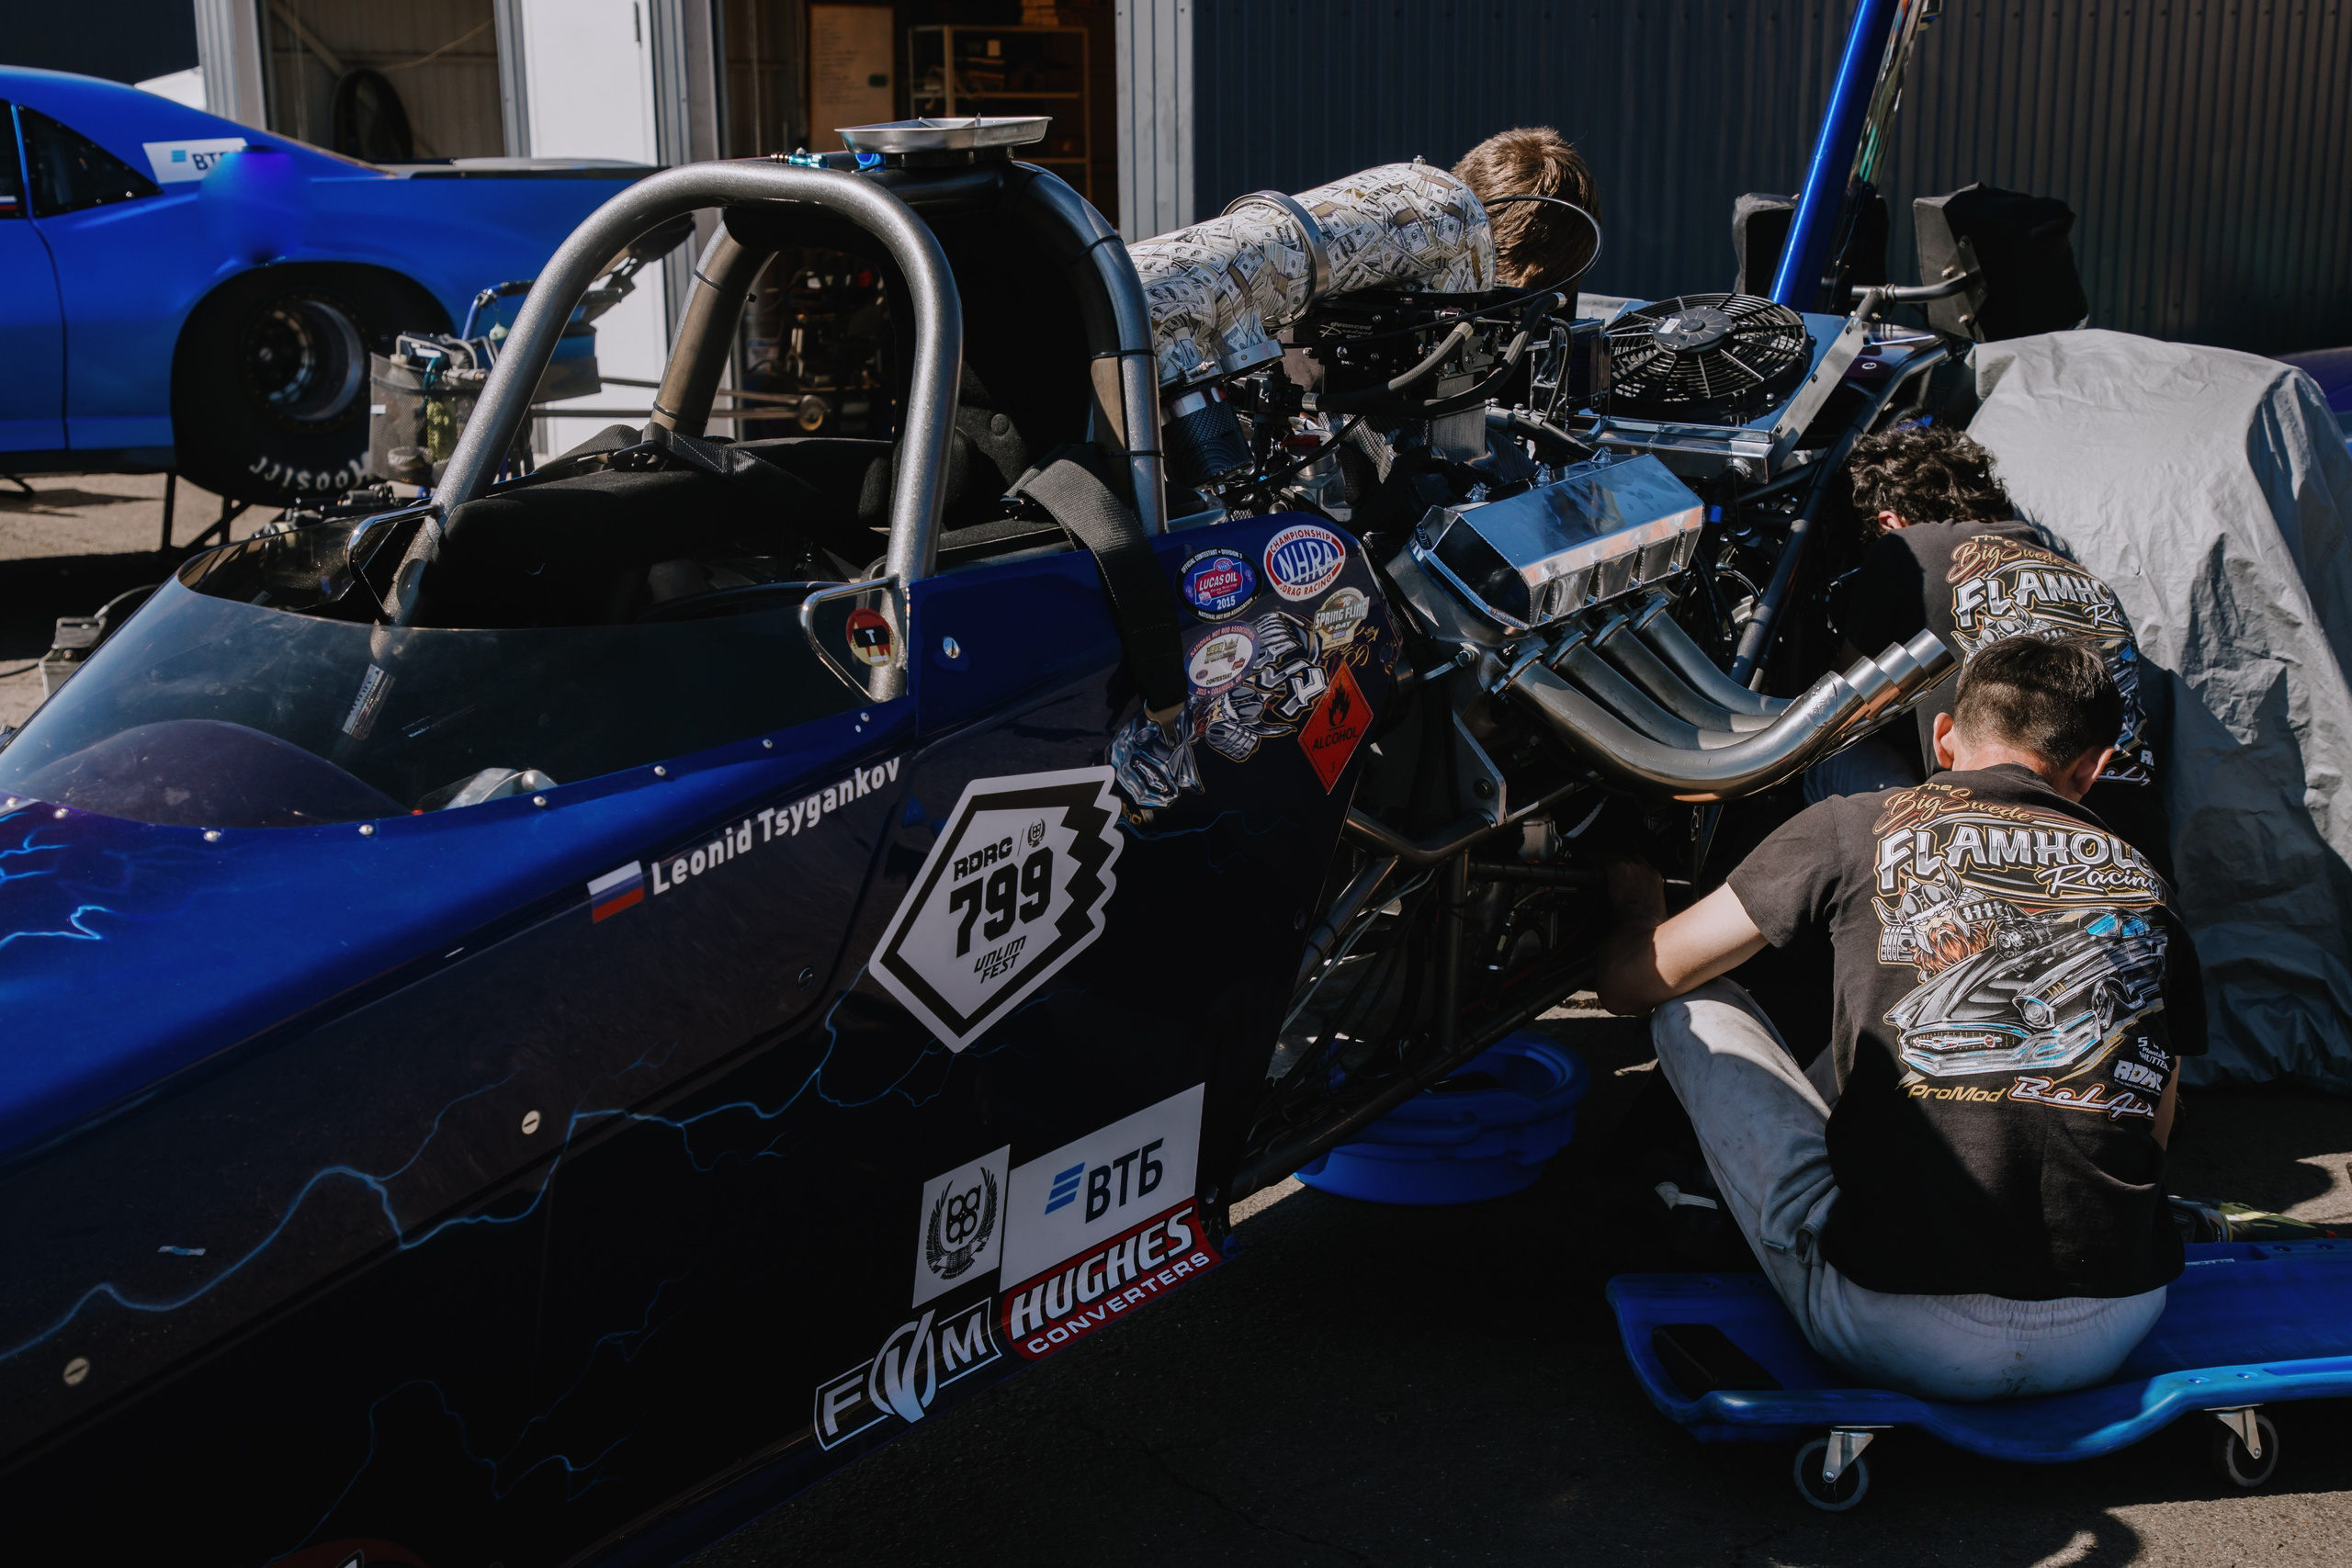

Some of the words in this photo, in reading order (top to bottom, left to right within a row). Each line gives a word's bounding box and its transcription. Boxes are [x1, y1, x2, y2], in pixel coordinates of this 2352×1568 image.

[192, 152, 229, 171] ВТ
[1270, 529, 1330, 553] CHAMPIONSHIP
[1971, 535, 2003, 543] The
[1276, 541, 1336, 583] NHRA
[1947, 542, 2004, 582] Big
[1999, 540, 2064, 566] Swede
[1199, 574, 1224, 591] LUCAS
[1225, 571, 1238, 585] OIL
[1283, 584, 1302, 597] DRAG
[1304, 574, 1332, 596] RACING
[1216, 595, 1236, 610] 2015
[1314, 608, 1345, 630] SPRING
[1344, 600, 1368, 622] FLING
[1190, 636, 1212, 658] NATIONAL
[1196, 687, 1207, 696] 2015
[1205, 672, 1233, 685] CONTESTANT
[1312, 728, 1358, 751] ALCOHOL
[1915, 783, 1953, 792] The
[1873, 790, 1942, 832] Big
[1939, 788, 2034, 821] Swede
[651, 818, 752, 896] Leonid
[757, 756, 900, 842] Tsygankov
[954, 836, 1012, 882] RDRC
[2037, 865, 2161, 900] Racing
[949, 846, 1054, 958] 799
[974, 935, 1027, 974] UNLIM
[980, 953, 1020, 985] FEST
[1907, 1084, 2007, 1103] ProMod
[1085, 1137, 1164, 1224] ВТБ
[1010, 1205, 1193, 1340] HUGHES
[1027, 1251, 1210, 1355] CONVERTERS
